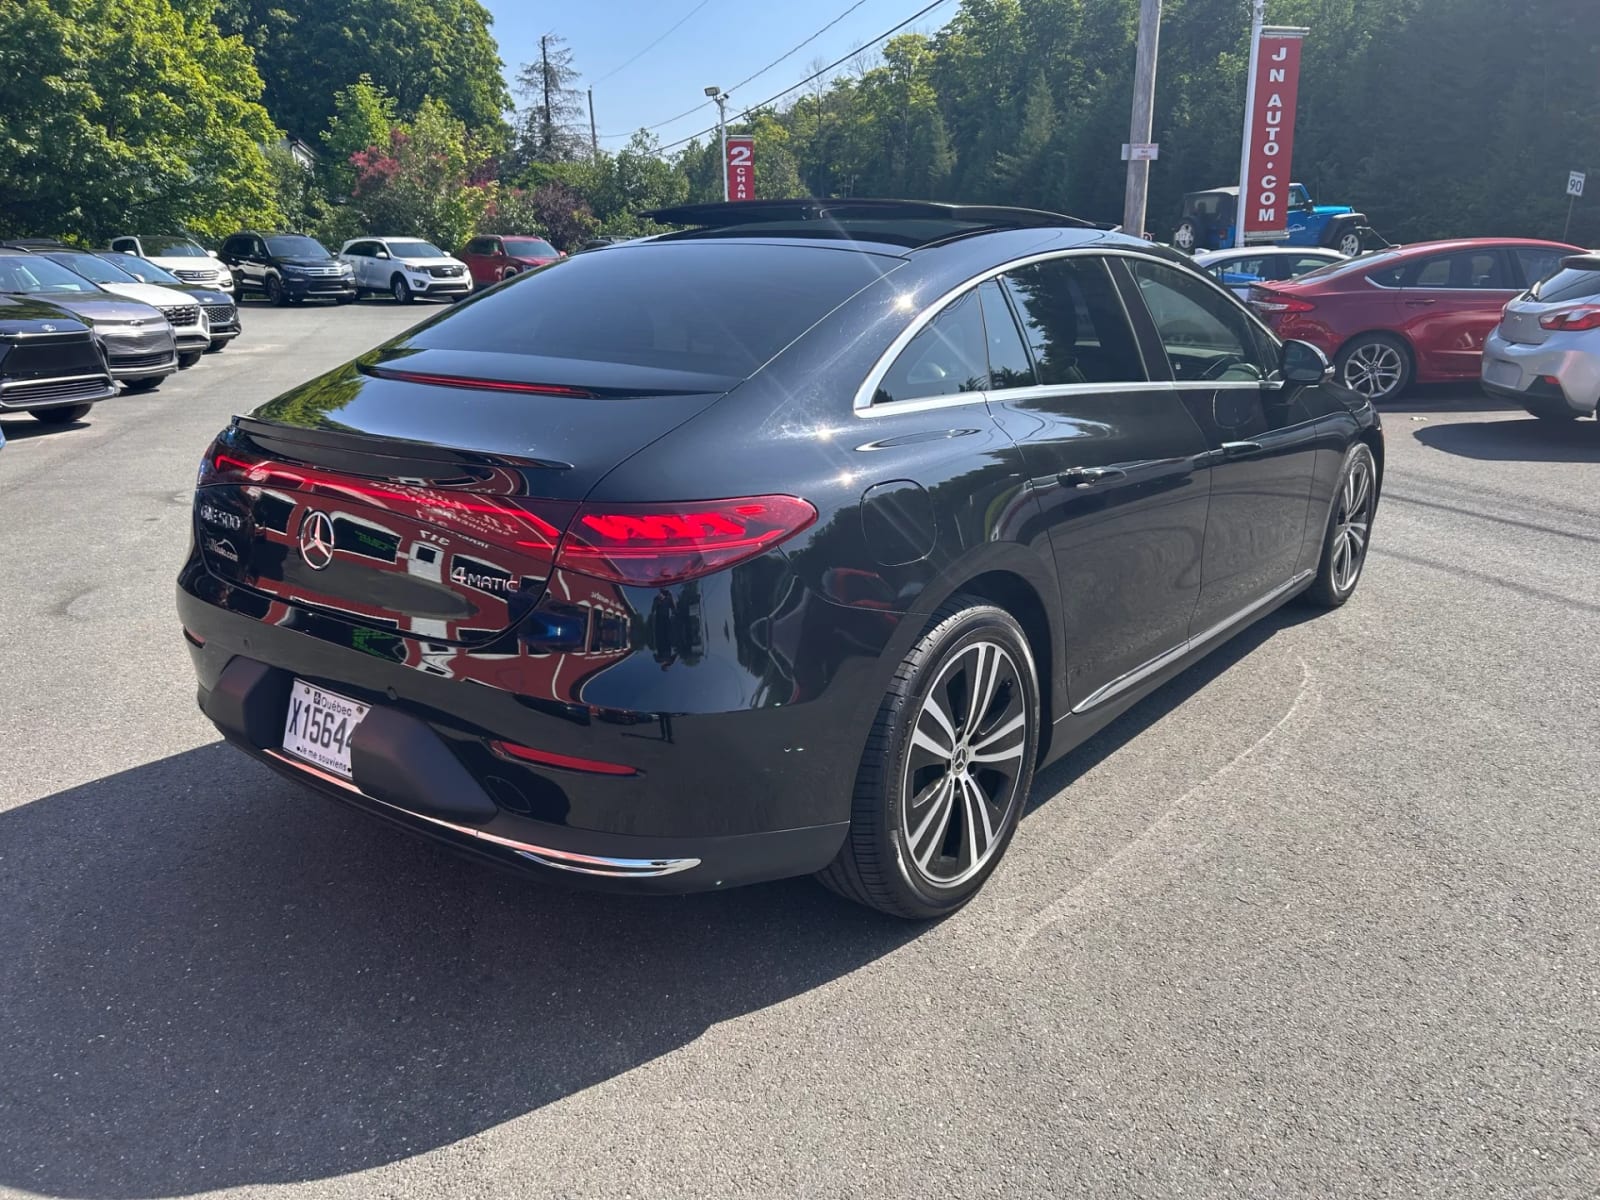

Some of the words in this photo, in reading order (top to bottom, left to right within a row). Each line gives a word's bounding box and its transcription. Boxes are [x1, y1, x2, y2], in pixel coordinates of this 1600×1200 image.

[1570, 179, 1582, 193] 90
[452, 566, 519, 593] 4MATIC
[320, 696, 352, 717] Québec
